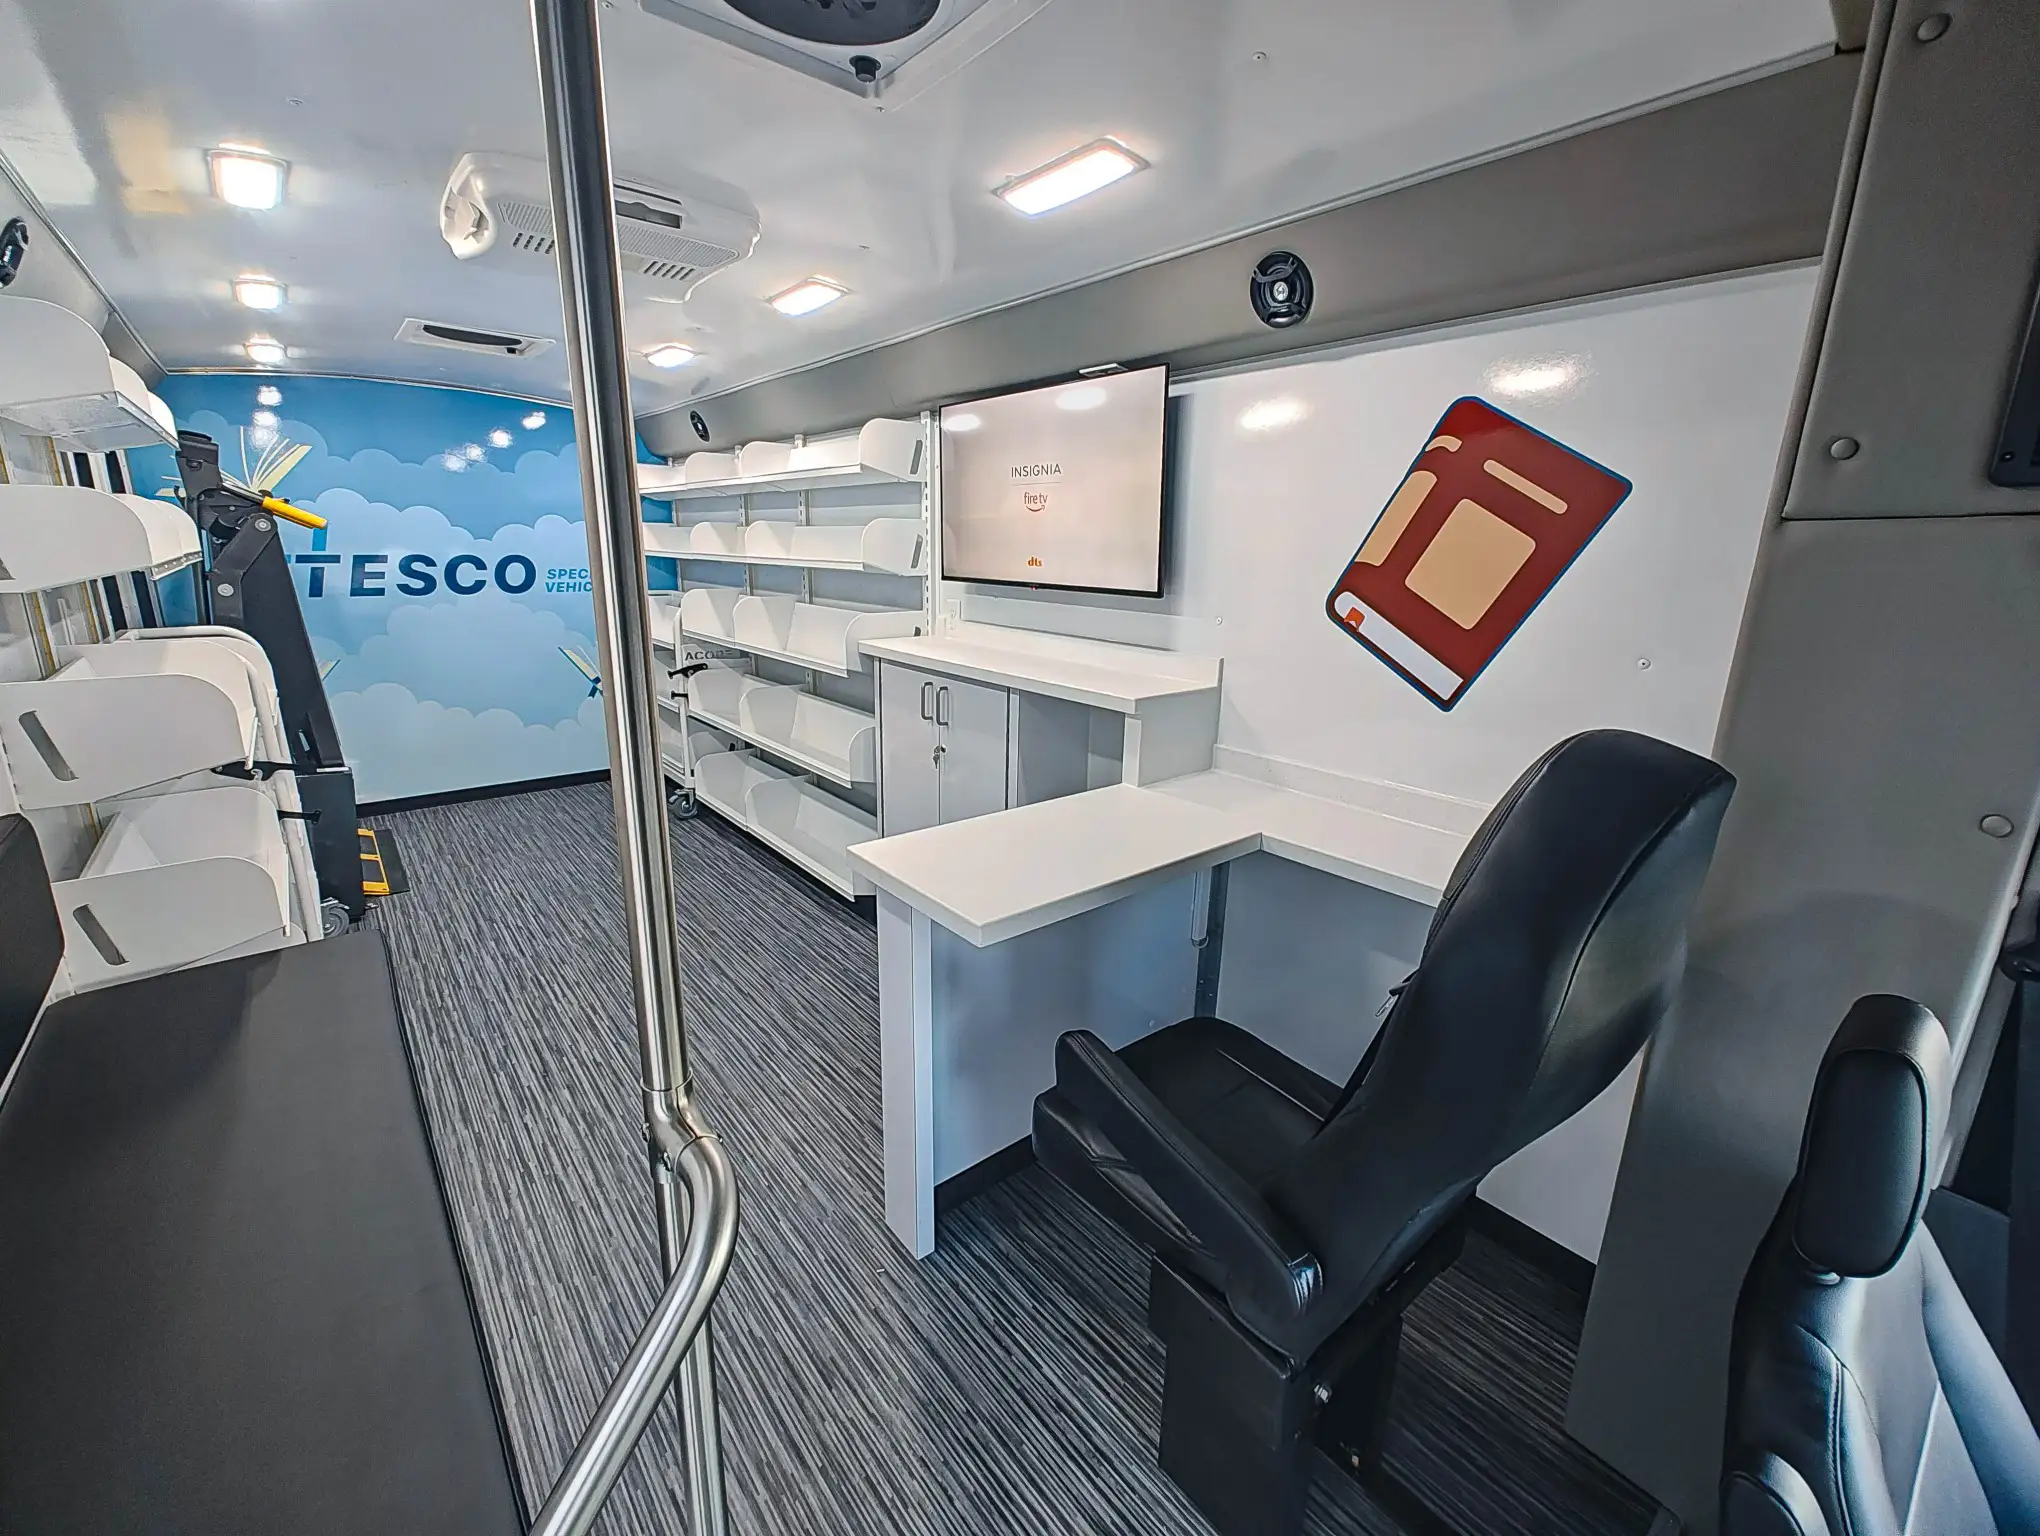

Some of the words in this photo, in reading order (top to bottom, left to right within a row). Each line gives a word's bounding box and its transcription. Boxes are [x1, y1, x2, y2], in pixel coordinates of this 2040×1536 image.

[1011, 463, 1062, 478] INSIGNIA
[1027, 556, 1043, 567] dts
[295, 554, 537, 598] TESCO
[547, 568, 592, 580] SPEC
